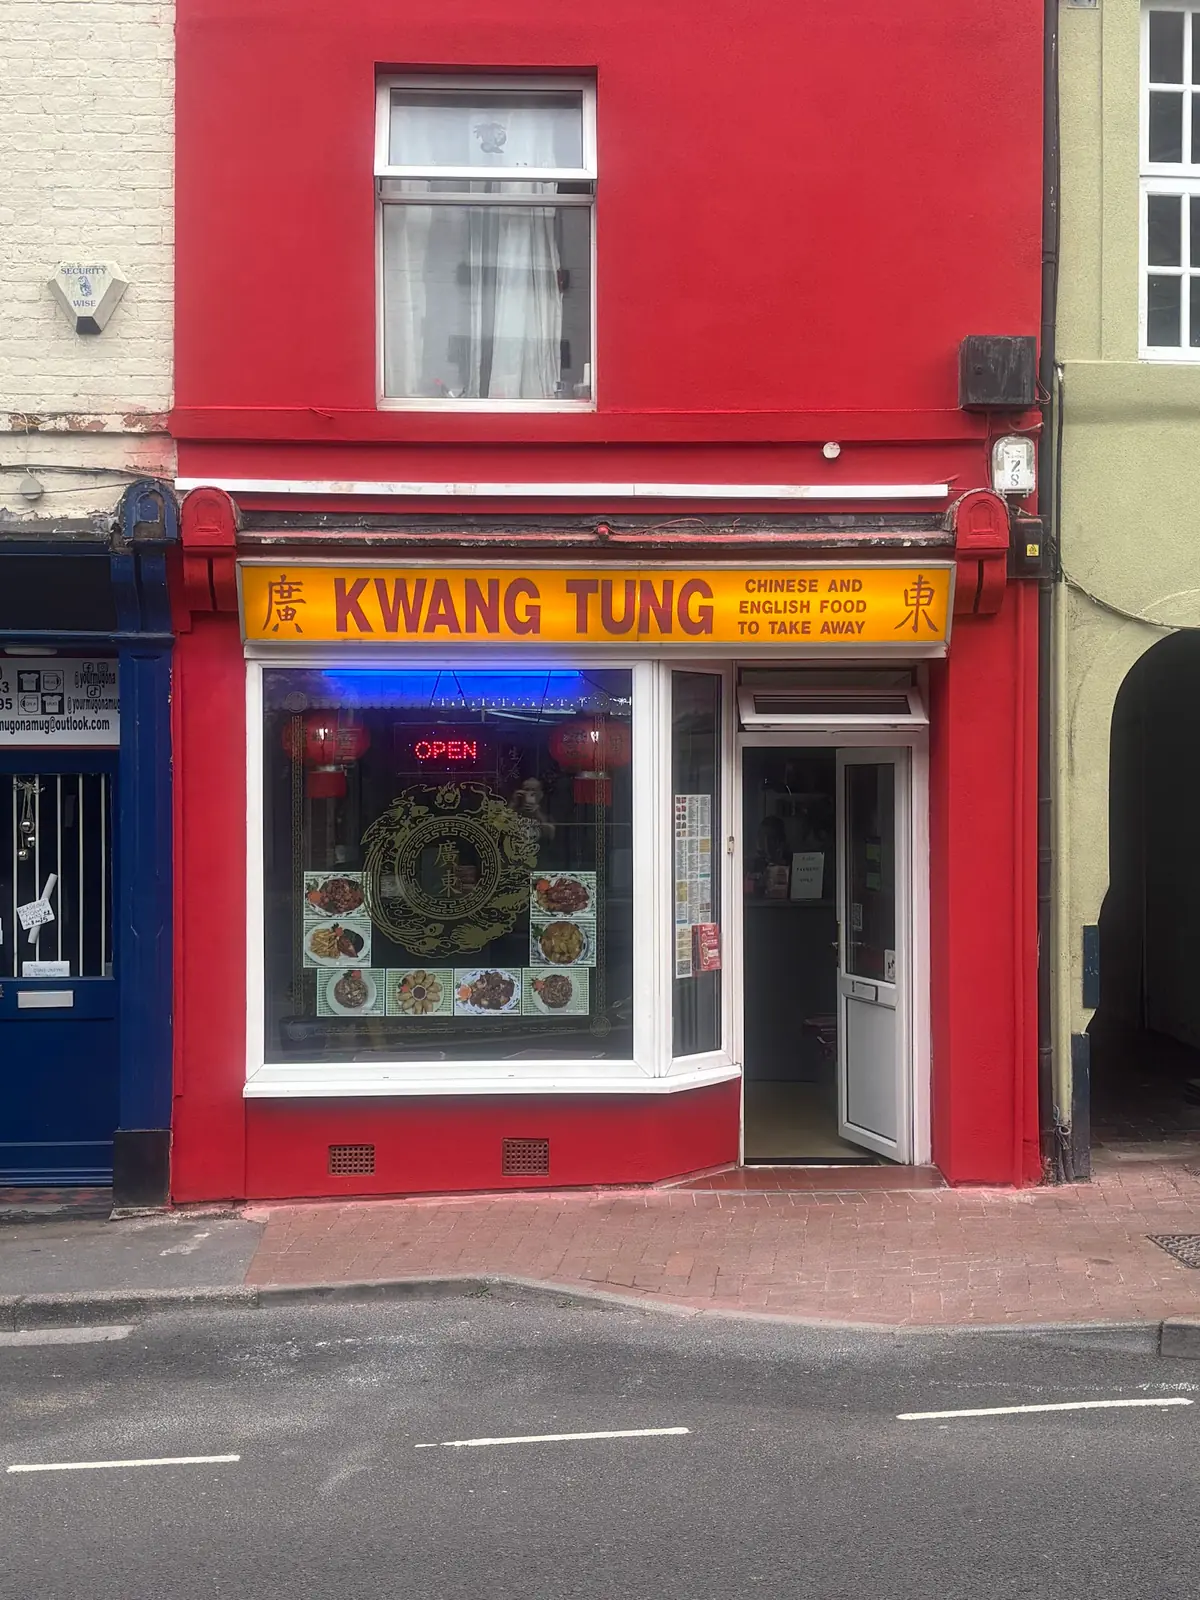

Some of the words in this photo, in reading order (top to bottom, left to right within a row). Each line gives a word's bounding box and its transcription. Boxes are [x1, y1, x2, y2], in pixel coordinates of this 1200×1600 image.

[745, 579, 818, 593] CHINESE
[827, 579, 863, 592] AND
[334, 577, 541, 635] KWANG
[566, 577, 714, 636] TUNG
[739, 600, 811, 614] ENGLISH
[820, 600, 867, 614] FOOD
[894, 574, 939, 634] 東
[738, 621, 760, 635] TO
[769, 621, 811, 635] TAKE
[820, 621, 865, 635] AWAY
[415, 741, 477, 760] OPEN
